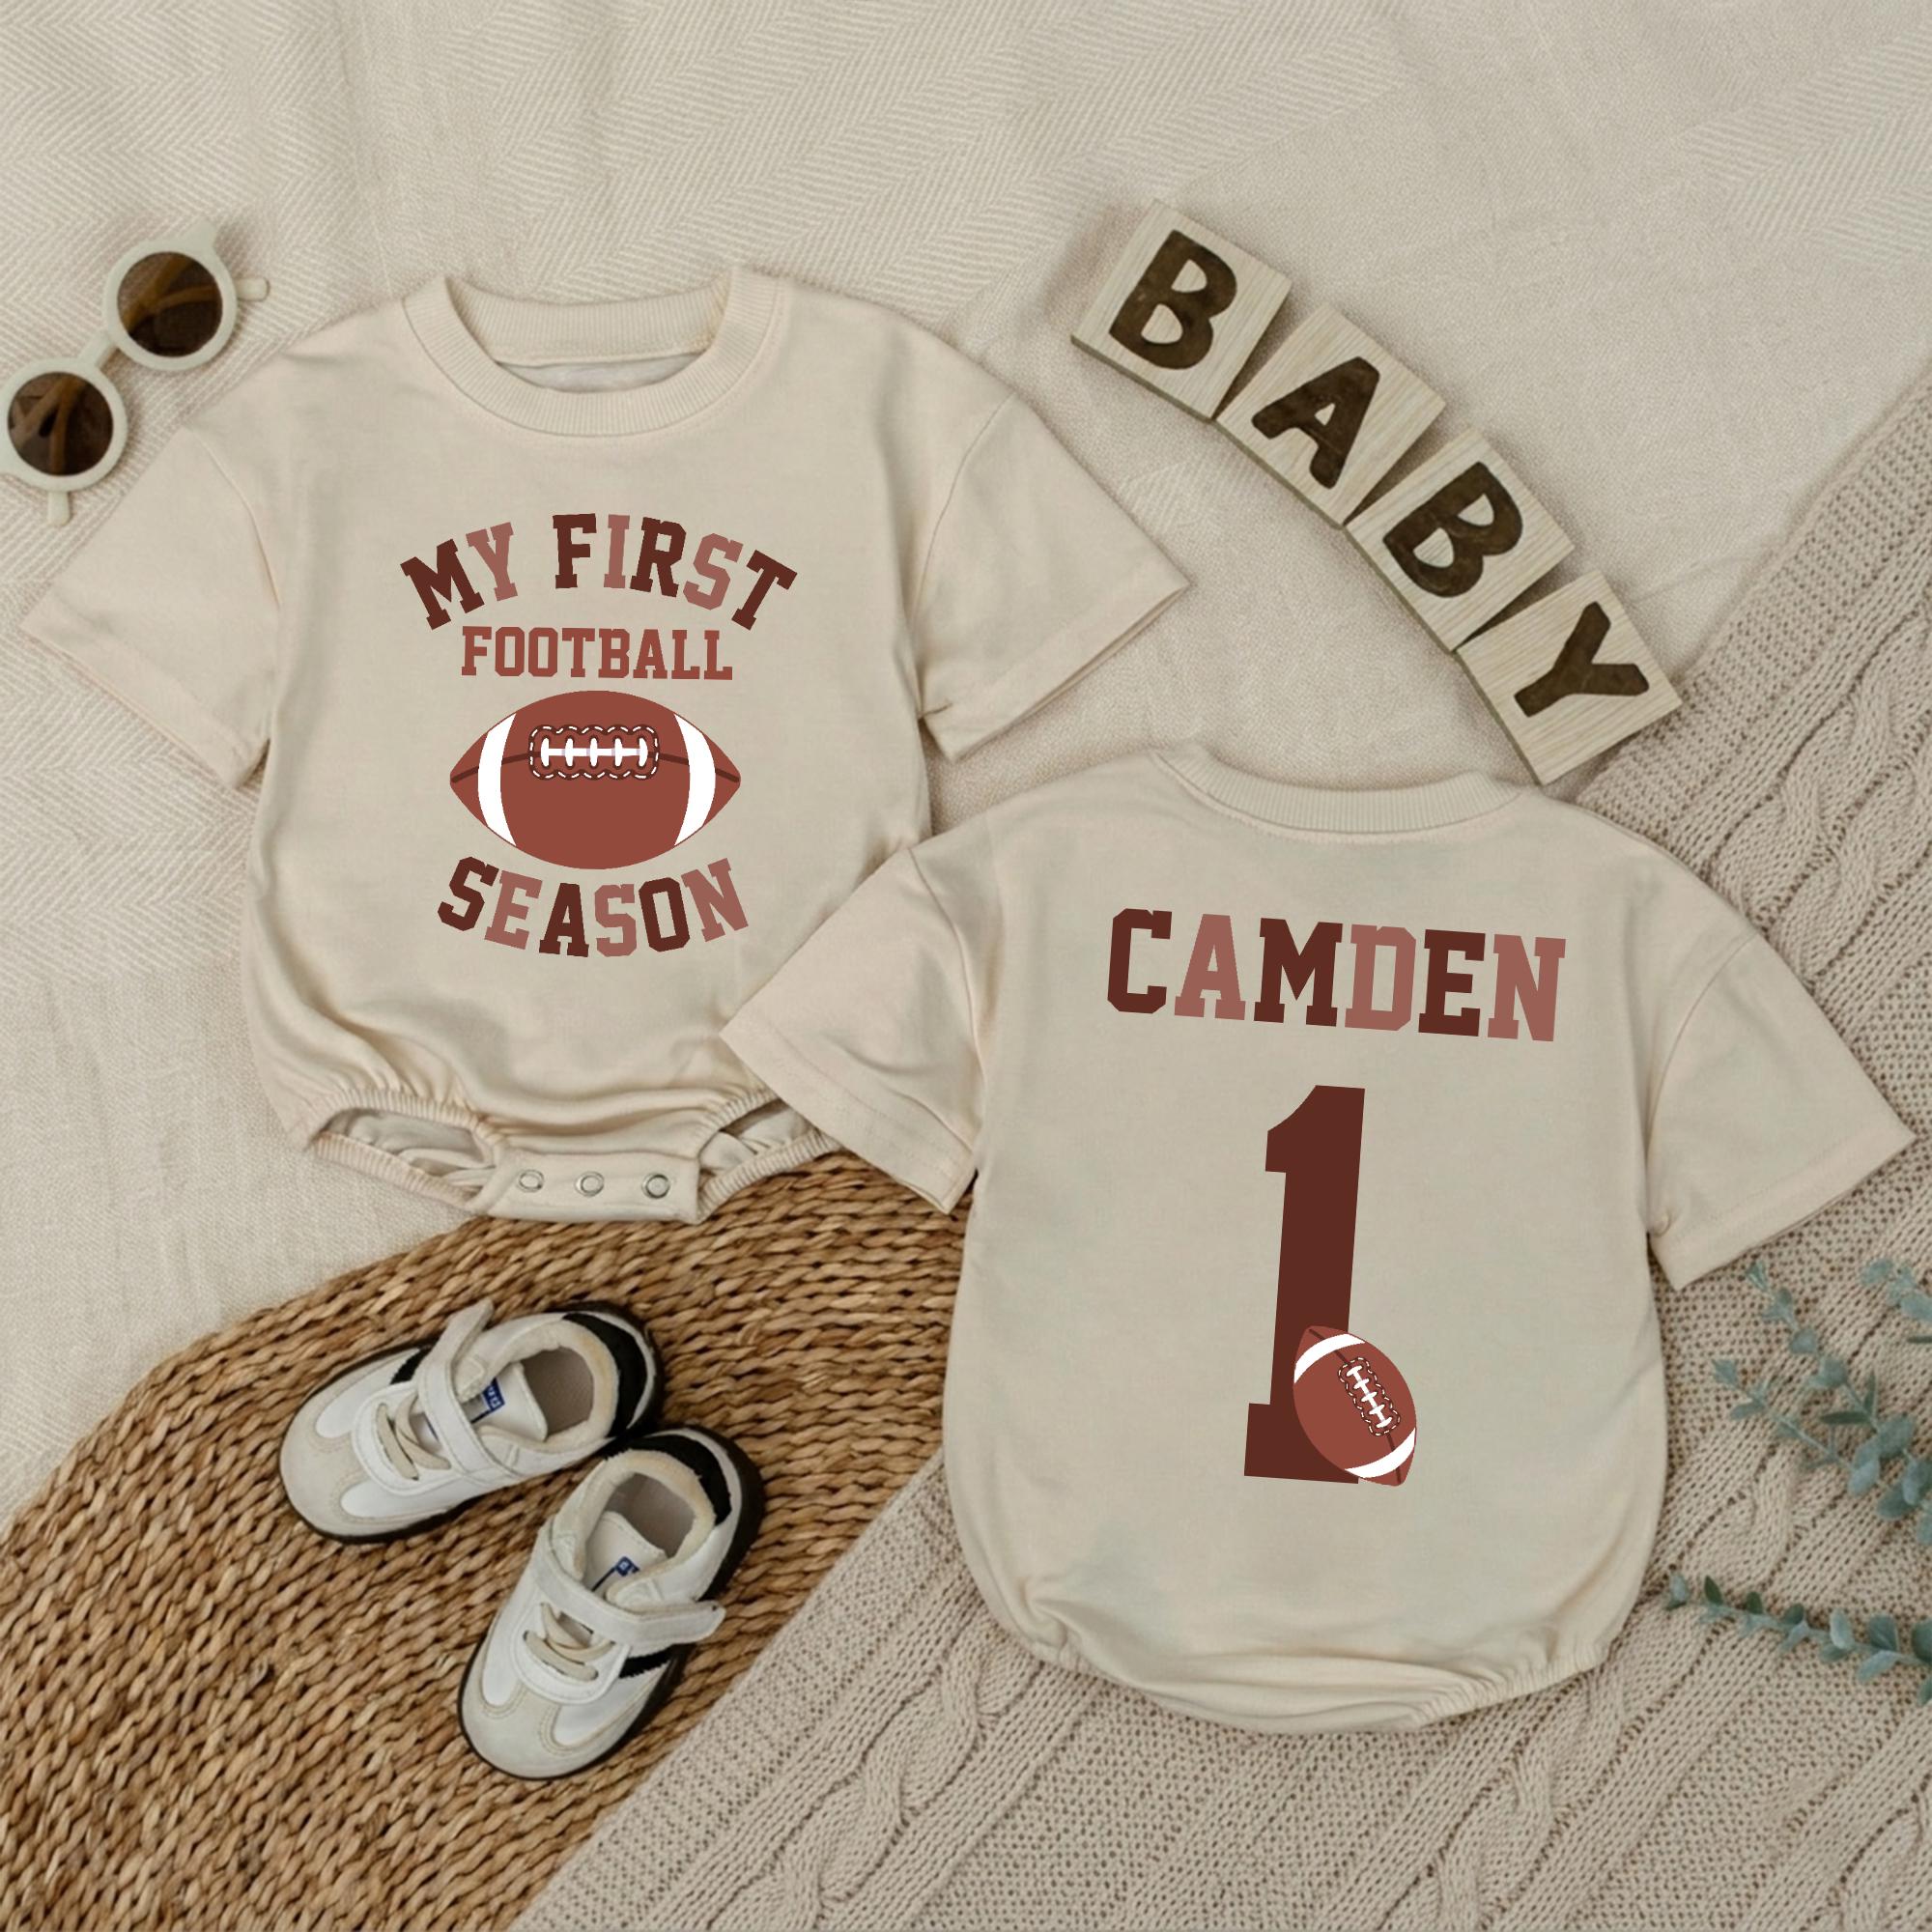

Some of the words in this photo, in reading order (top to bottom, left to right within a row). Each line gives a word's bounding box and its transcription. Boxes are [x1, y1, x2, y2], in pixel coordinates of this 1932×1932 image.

[1108, 229, 1650, 718] BABY
[399, 522, 519, 631] MY
[552, 512, 798, 632] FIRST
[461, 625, 733, 681] FOOTBALL
[437, 856, 750, 958] SEASON
[1106, 907, 1567, 1042] CAMDEN
[1243, 1084, 1366, 1485] 1
